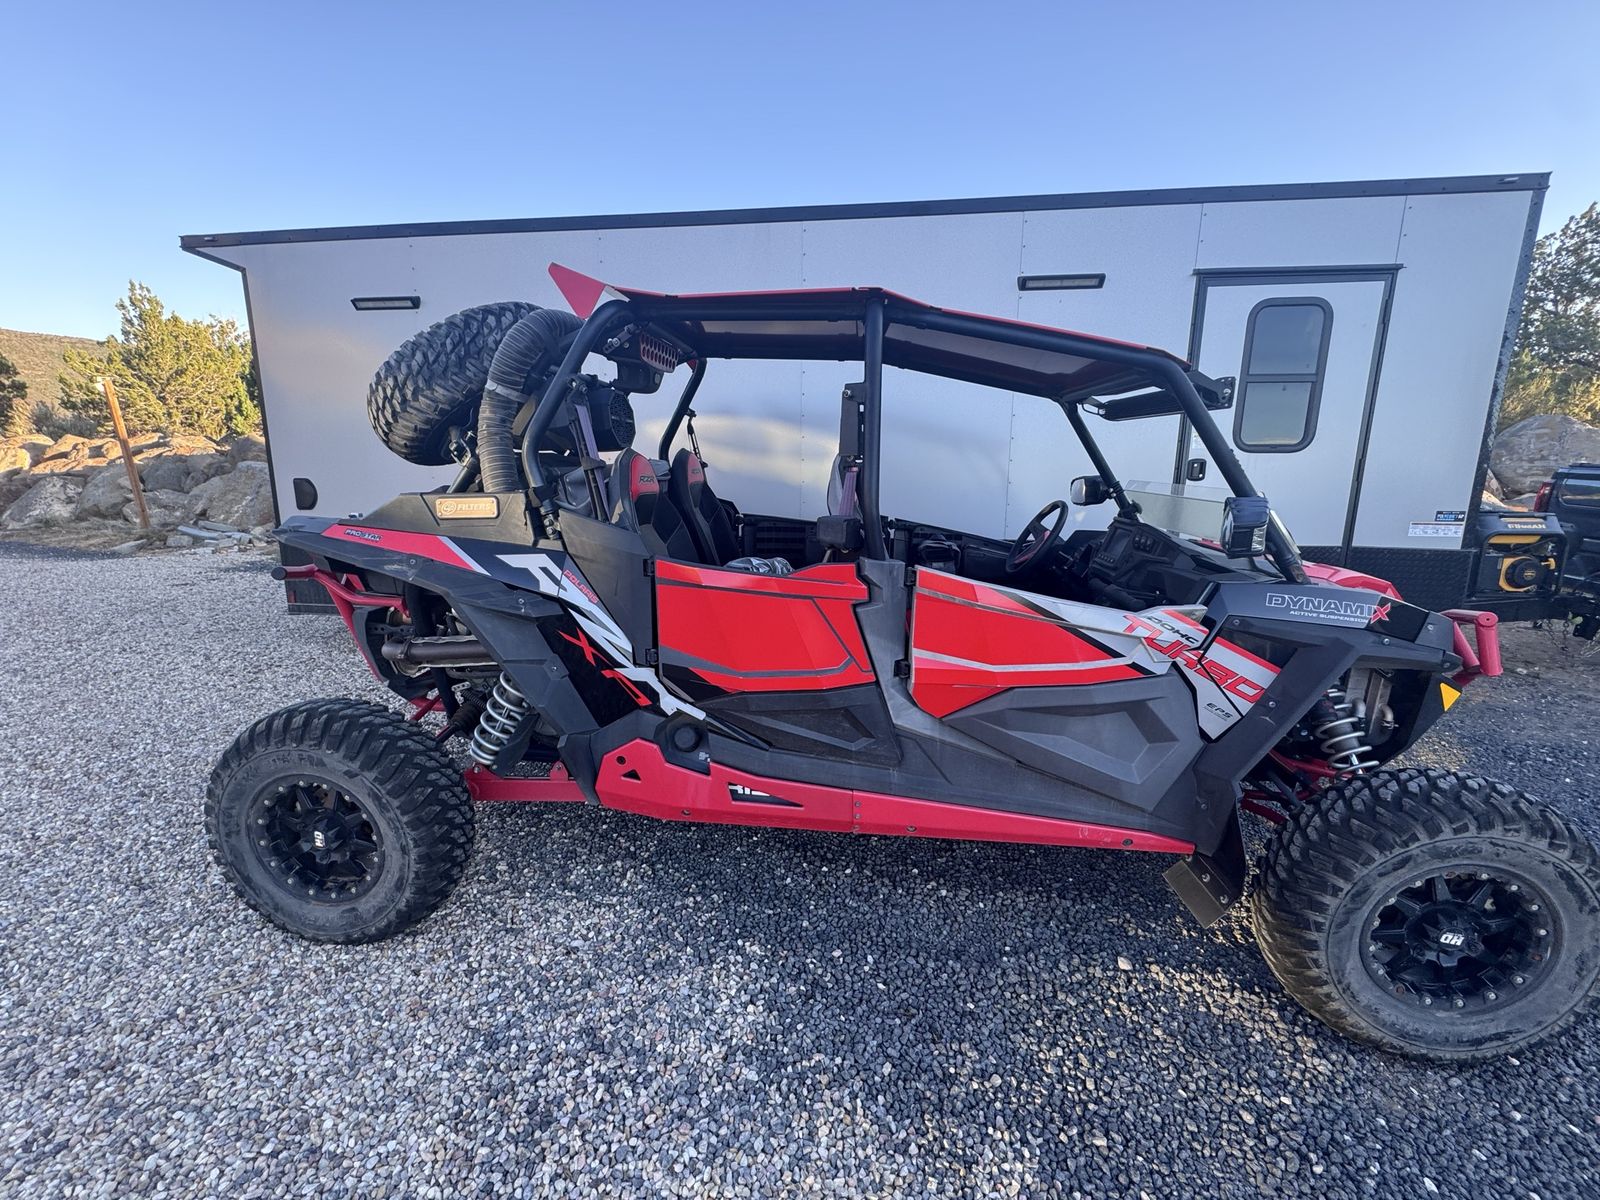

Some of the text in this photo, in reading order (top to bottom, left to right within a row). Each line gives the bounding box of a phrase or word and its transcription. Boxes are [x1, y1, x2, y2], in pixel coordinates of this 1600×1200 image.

[562, 569, 599, 604] POLARIS
[1265, 592, 1391, 624] DYNAMIX
[1289, 610, 1369, 623] ACTIVE SUSPENSION
[1146, 615, 1200, 645] DOHC
[1123, 614, 1266, 704] TURBO
[1206, 702, 1234, 719] EPS
[1440, 933, 1465, 946] HD
